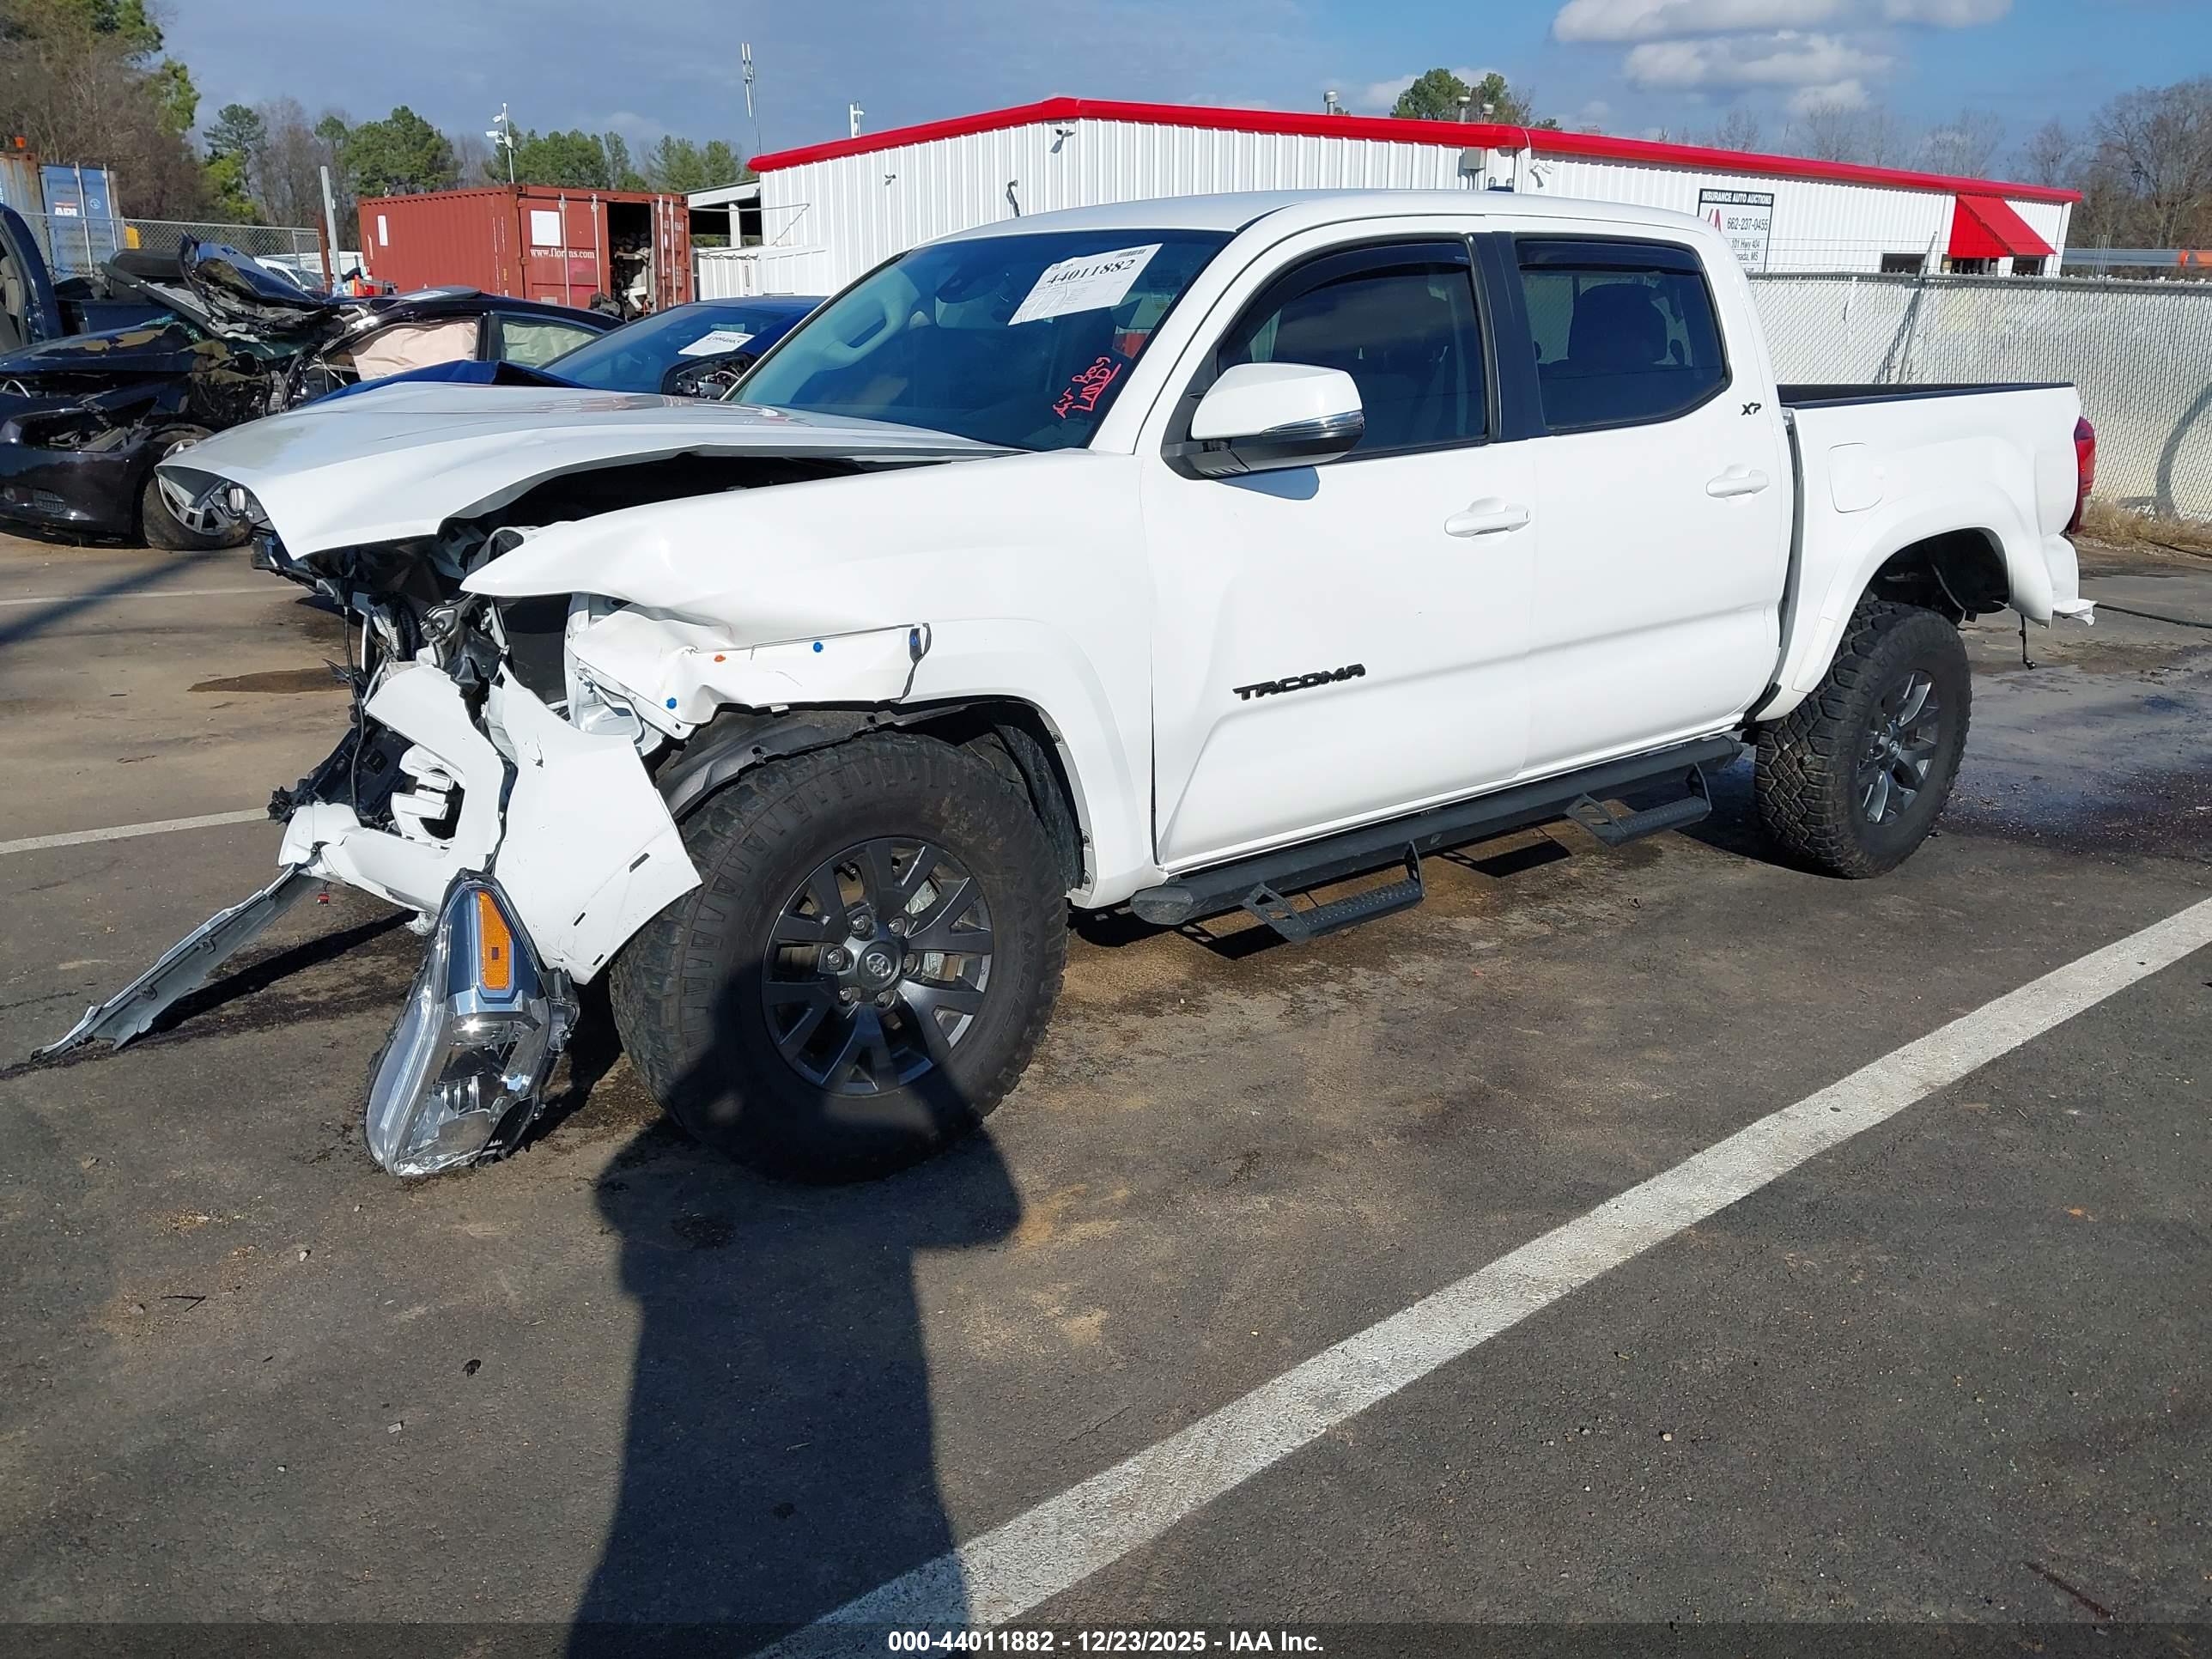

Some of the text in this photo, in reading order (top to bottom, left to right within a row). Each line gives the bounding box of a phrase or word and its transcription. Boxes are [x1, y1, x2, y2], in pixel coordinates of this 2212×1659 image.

[1702, 191, 1772, 205] INSURANCE AUTO AUCTIONS
[1727, 217, 1769, 231] 662-237-0455
[530, 247, 595, 259] www.florns.com
[1737, 252, 1750, 261] nada,
[1047, 259, 1136, 284] 44011882
[1741, 402, 1762, 416] XP
[1232, 663, 1366, 702] TACOMA
